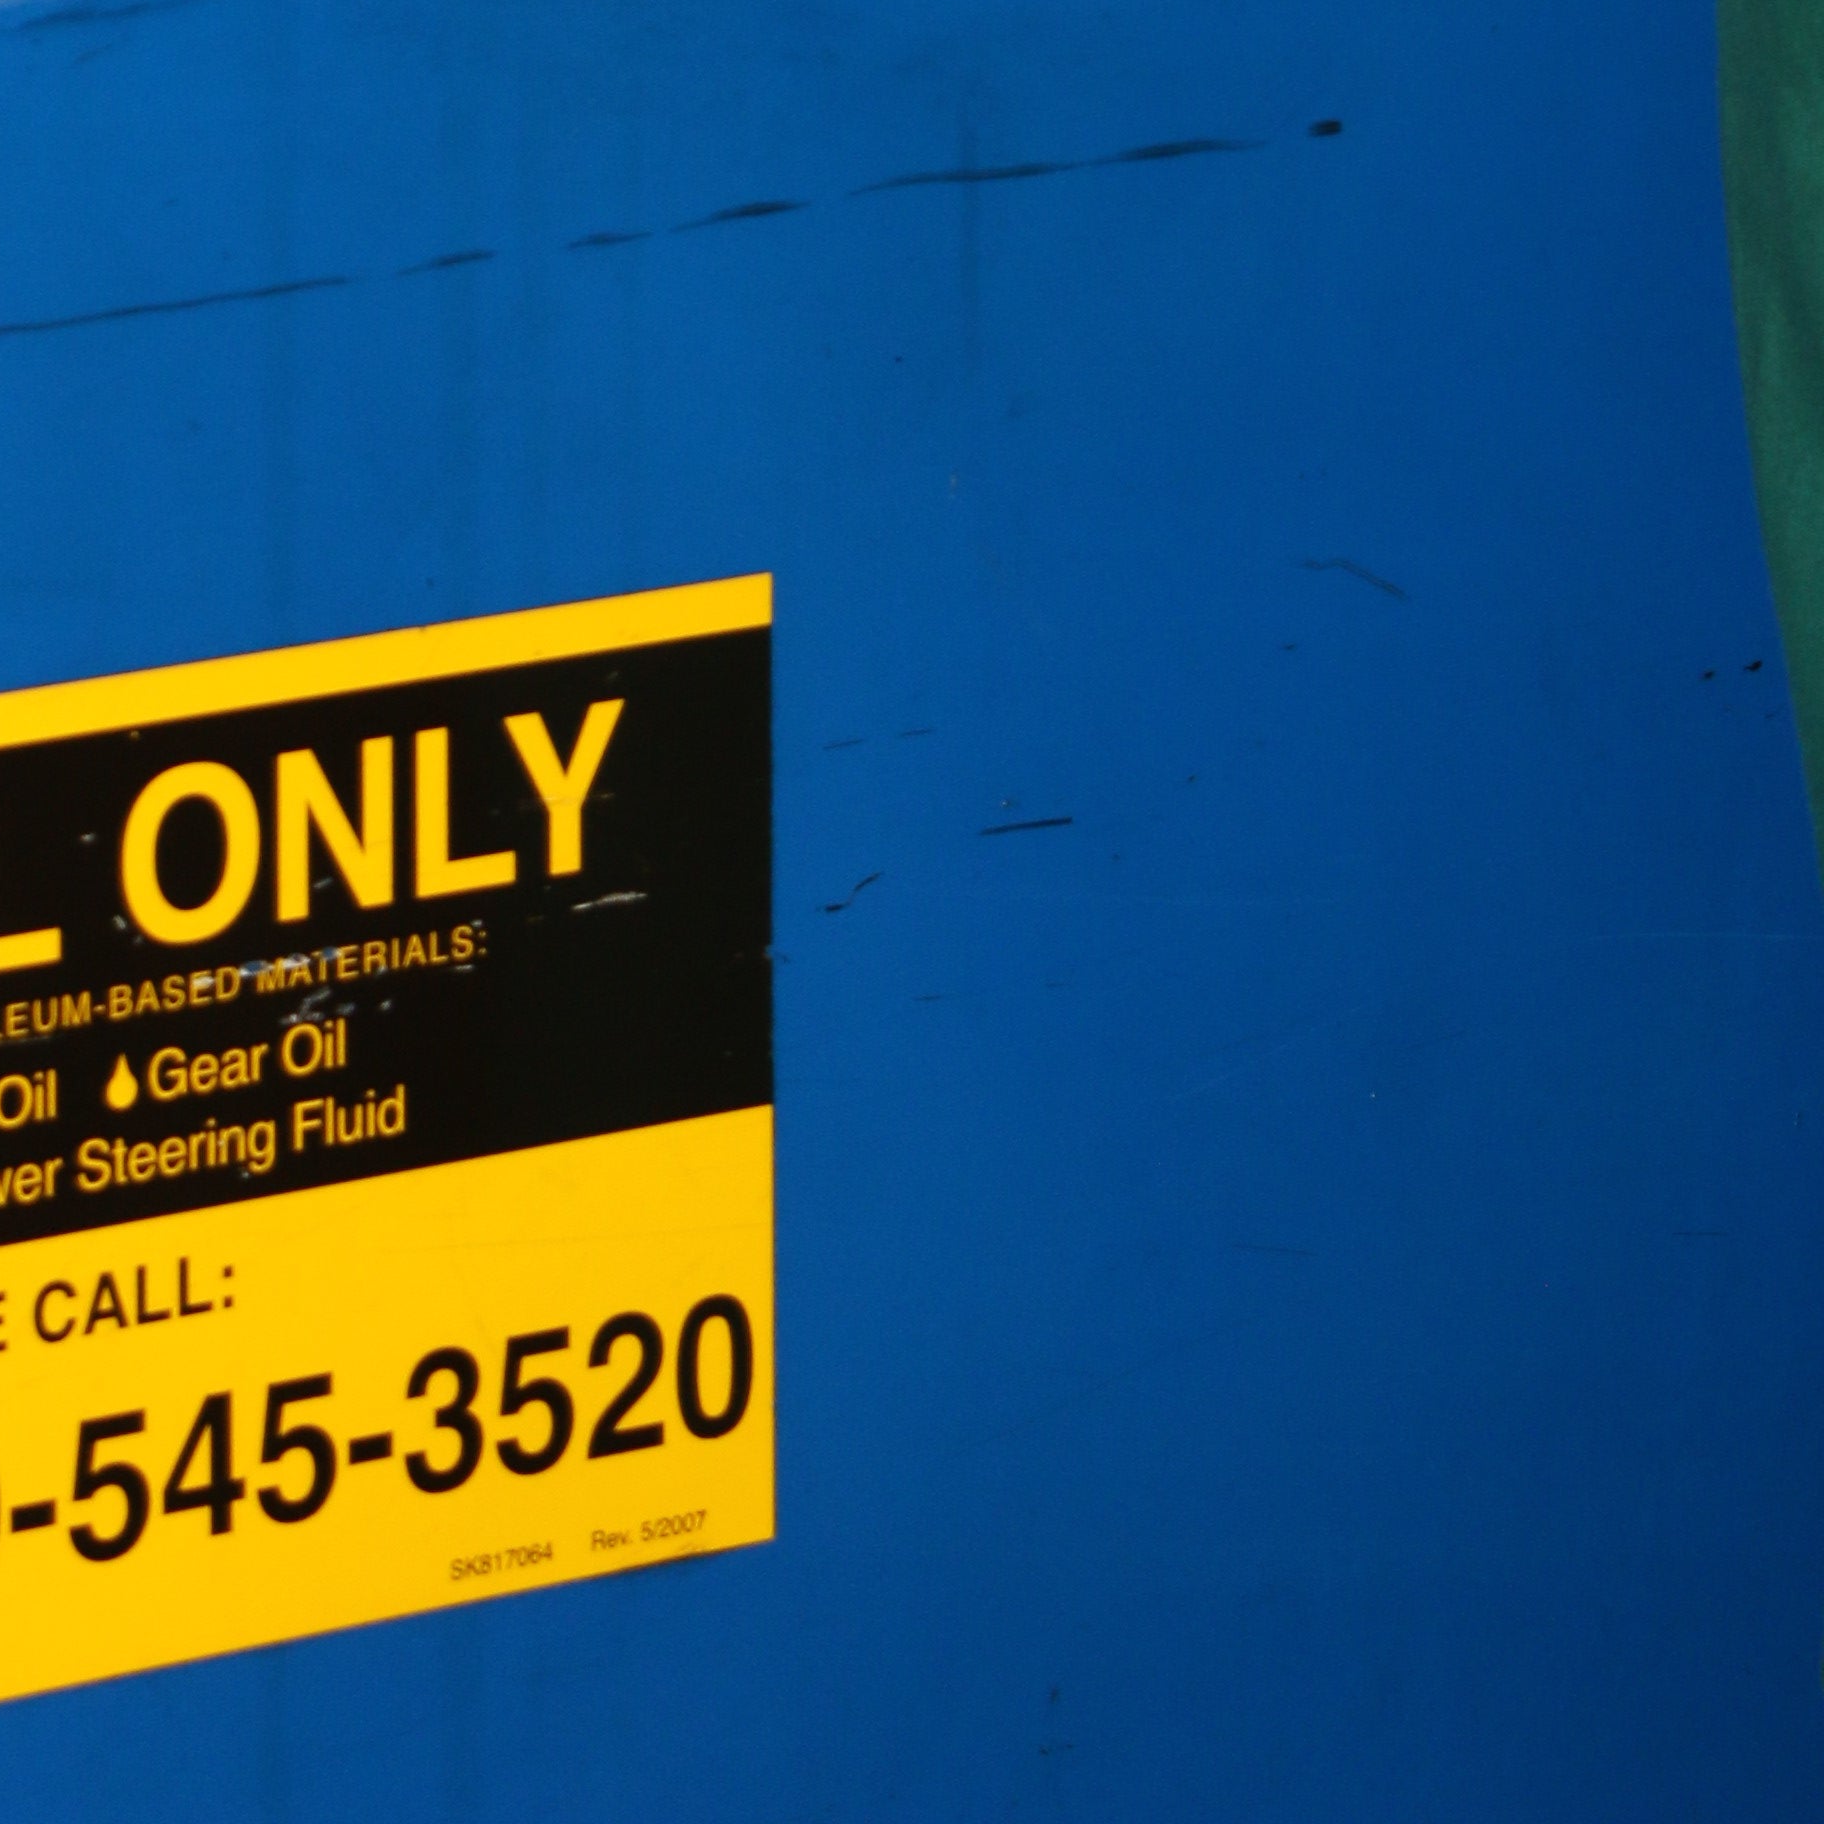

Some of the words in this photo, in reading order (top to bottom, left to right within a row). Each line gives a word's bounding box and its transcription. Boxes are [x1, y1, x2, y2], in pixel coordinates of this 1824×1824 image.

[118, 697, 628, 946] ONLY
[255, 925, 488, 992] MATERIALS:
[147, 1043, 268, 1101] Gear
[281, 1015, 346, 1077] Oil
[76, 1118, 276, 1192] Steering
[293, 1085, 406, 1151] Fluid
[34, 1257, 235, 1343] CALL:
[590, 1529, 633, 1552] Rev.
[639, 1509, 708, 1542] 5/2007
